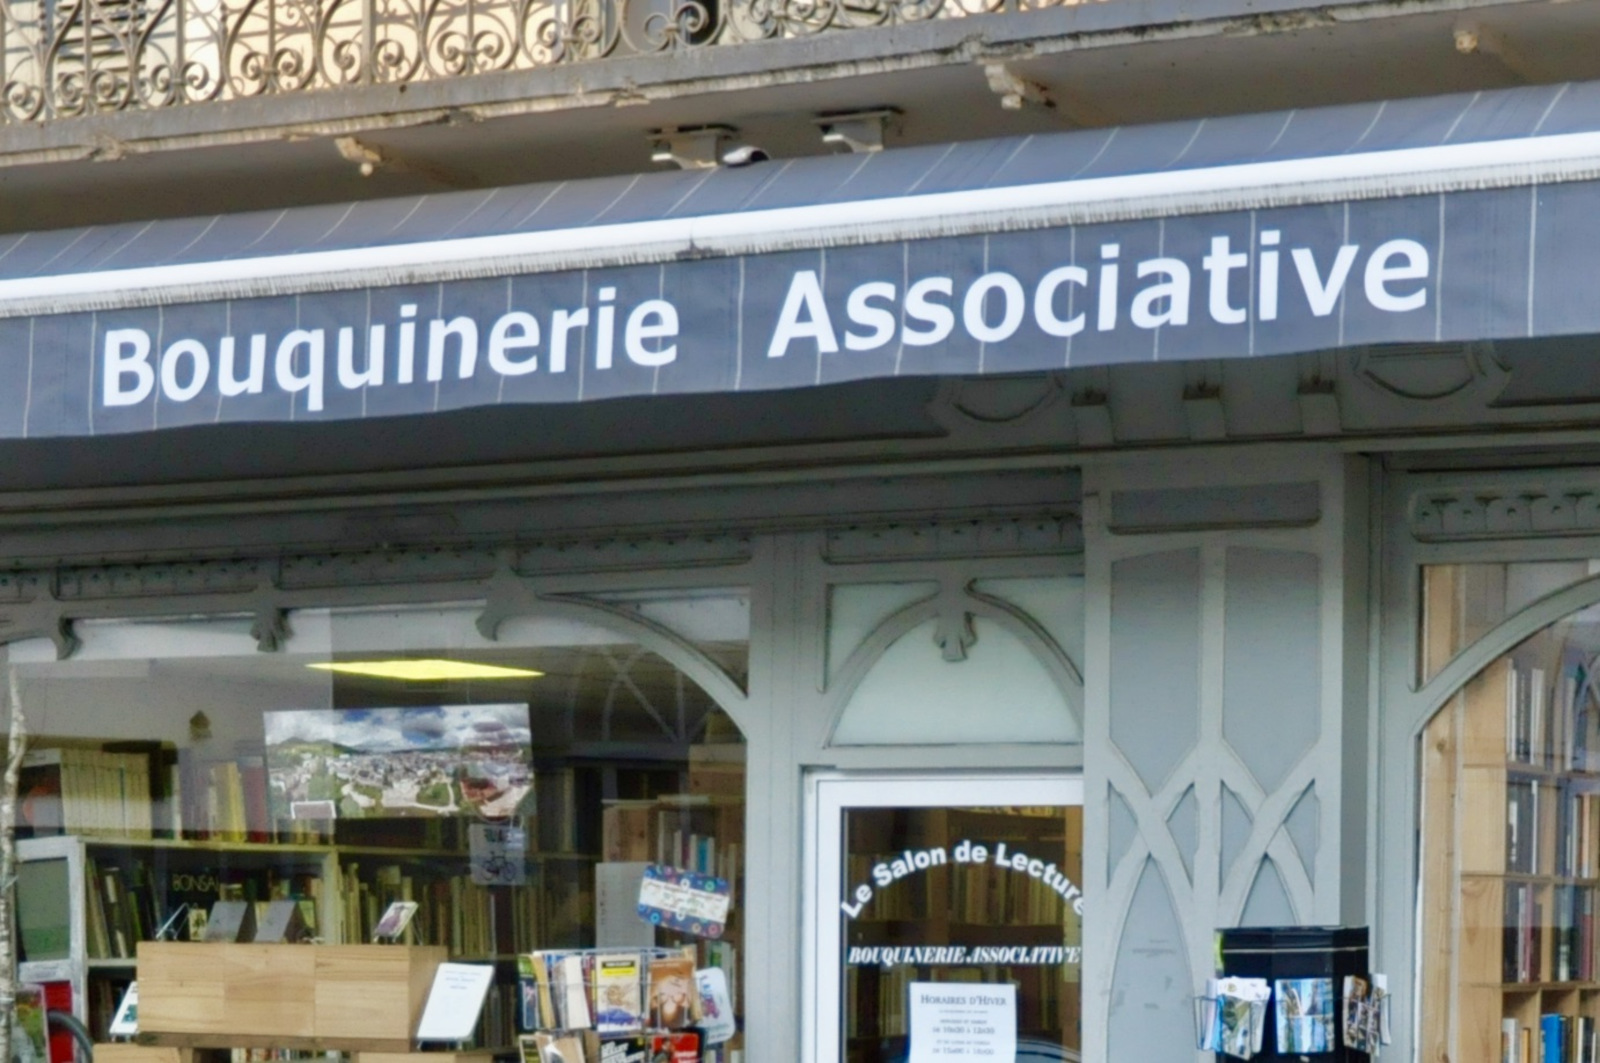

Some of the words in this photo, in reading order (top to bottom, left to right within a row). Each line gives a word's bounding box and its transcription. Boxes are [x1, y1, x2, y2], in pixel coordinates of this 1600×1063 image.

[103, 287, 679, 412] Bouquinerie
[767, 229, 1429, 358] Associative
[841, 883, 873, 919] Le
[872, 845, 947, 887] Salon
[954, 839, 988, 863] de
[848, 946, 966, 967] BOUQUINERIE
[966, 946, 1081, 964] ASSOCIATIVE
